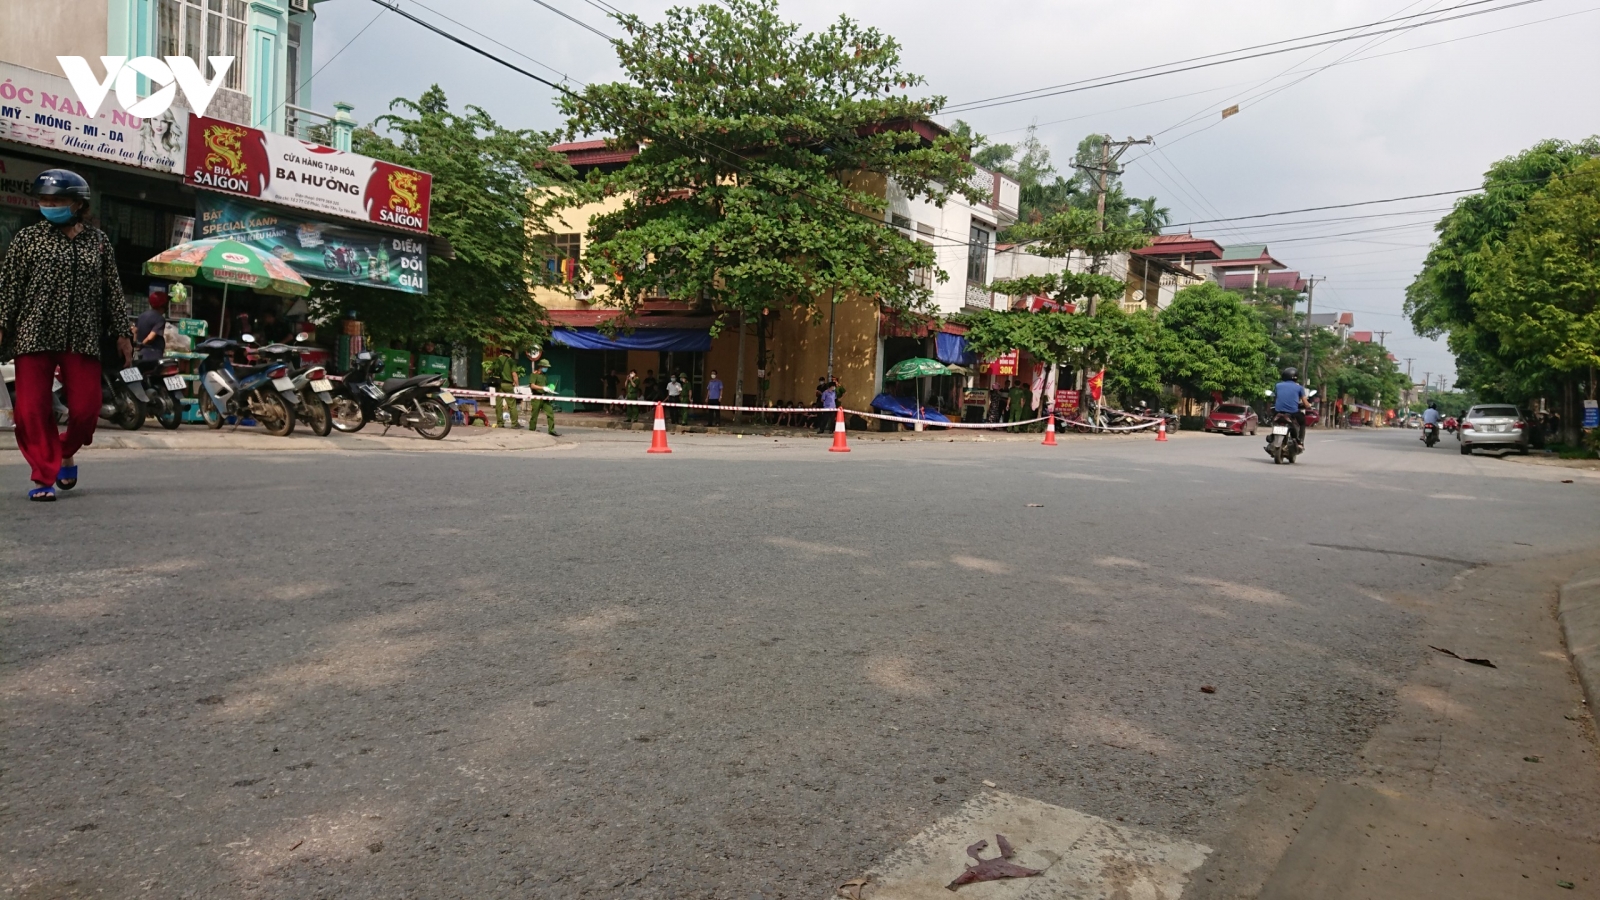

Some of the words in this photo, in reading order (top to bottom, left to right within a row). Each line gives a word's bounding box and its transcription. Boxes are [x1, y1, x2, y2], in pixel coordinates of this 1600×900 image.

[1, 105, 22, 119] MỸ
[34, 112, 72, 131] MÓNG
[83, 124, 98, 137] MI
[109, 131, 124, 142] DA
[61, 134, 95, 153] Nhận
[97, 142, 116, 156] đào
[118, 148, 135, 161] tạo
[137, 148, 153, 165] học
[213, 166, 231, 176] BIA
[283, 152, 301, 164] CỬA
[301, 156, 323, 169] HÀNG
[324, 162, 339, 174] TẠP
[339, 166, 355, 177] HÓA
[193, 170, 249, 193] SAIGON
[275, 167, 297, 182] BA
[301, 172, 360, 196] HƯỞNG
[202, 210, 223, 223] BẬT
[379, 208, 423, 228] SAIGON
[395, 205, 409, 214] BIA
[202, 220, 246, 235] SPECIAL
[248, 217, 278, 228] XANH
[391, 238, 423, 255] ĐIỂM
[400, 256, 423, 272] ĐỔI
[398, 273, 423, 289] GIẢI
[999, 366, 1014, 374] 30K
